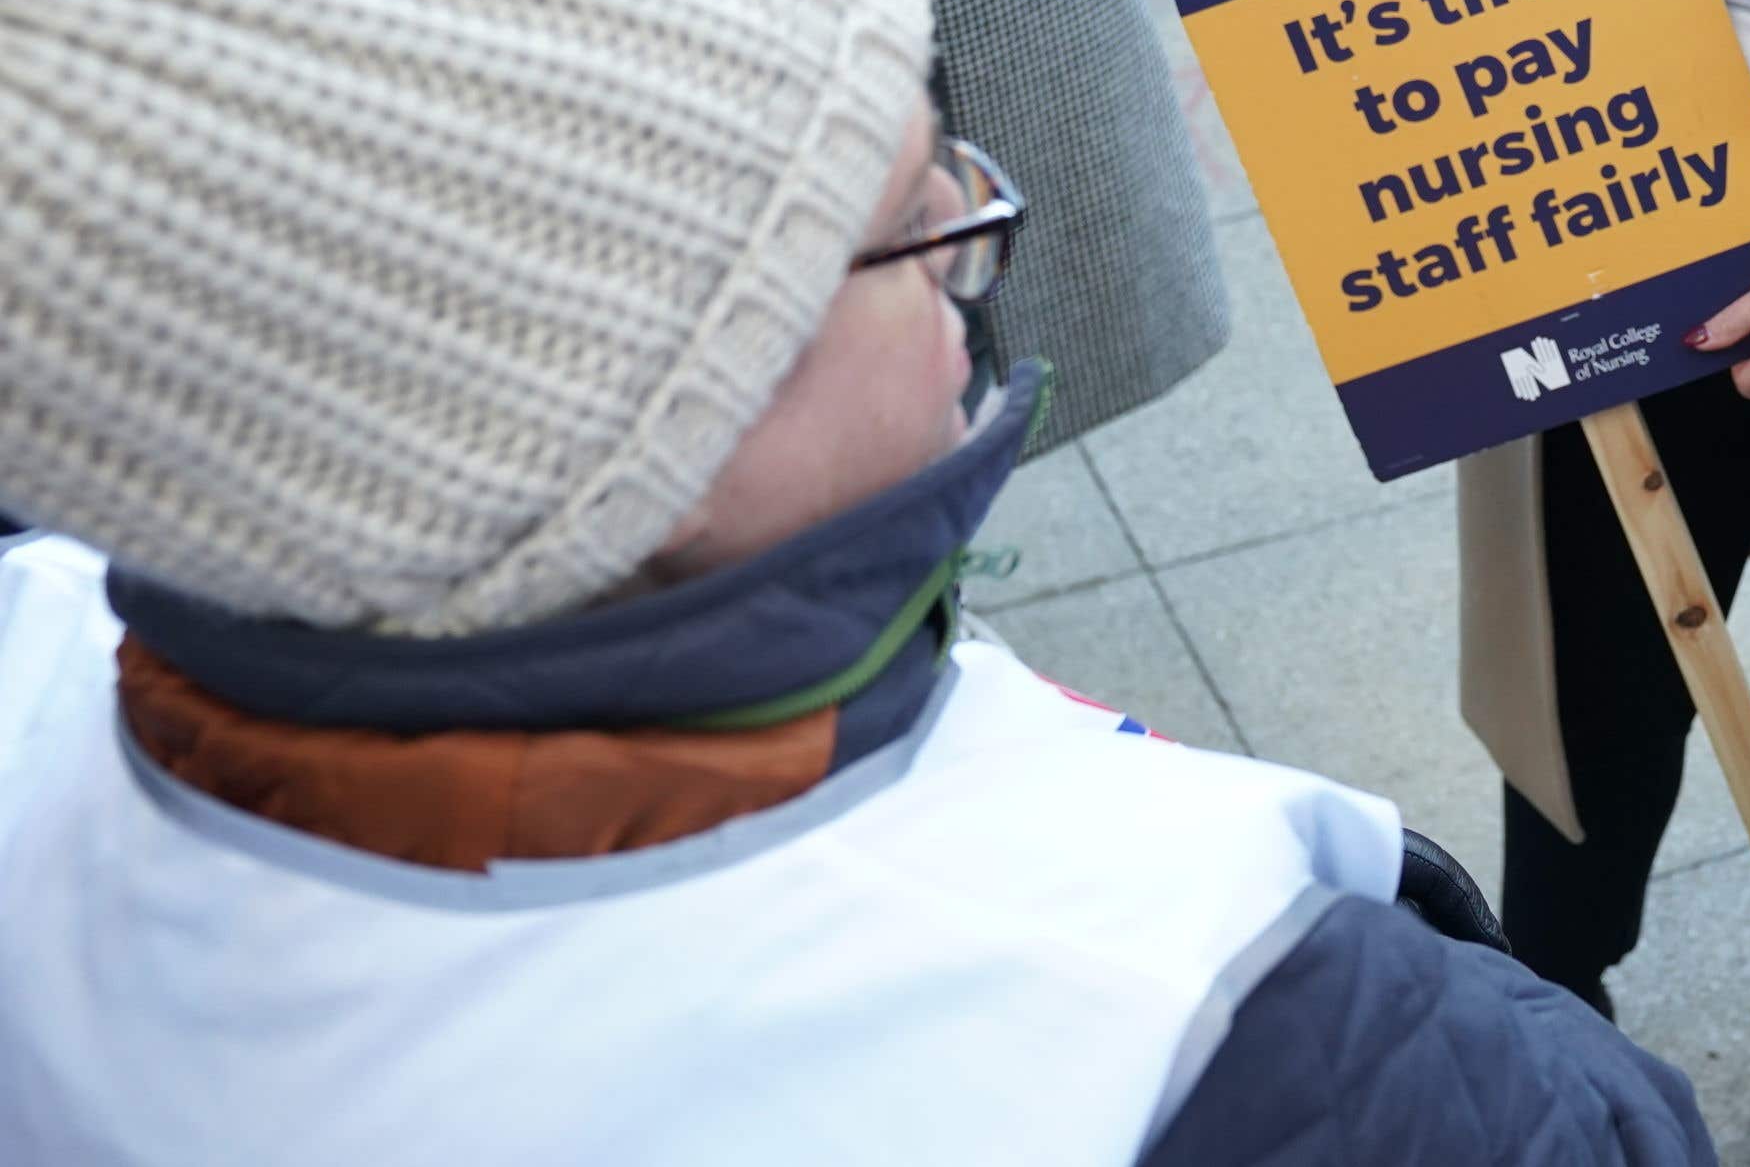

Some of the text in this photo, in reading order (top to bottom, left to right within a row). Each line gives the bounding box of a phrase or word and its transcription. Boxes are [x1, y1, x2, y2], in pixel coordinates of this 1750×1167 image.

[1284, 0, 1411, 75] It's
[1354, 17, 1593, 135] to pay
[1357, 85, 1660, 224] nursing
[1340, 141, 1729, 313] staff fairly
[1567, 322, 1662, 365] Royal College
[1575, 348, 1651, 382] of Nursing
